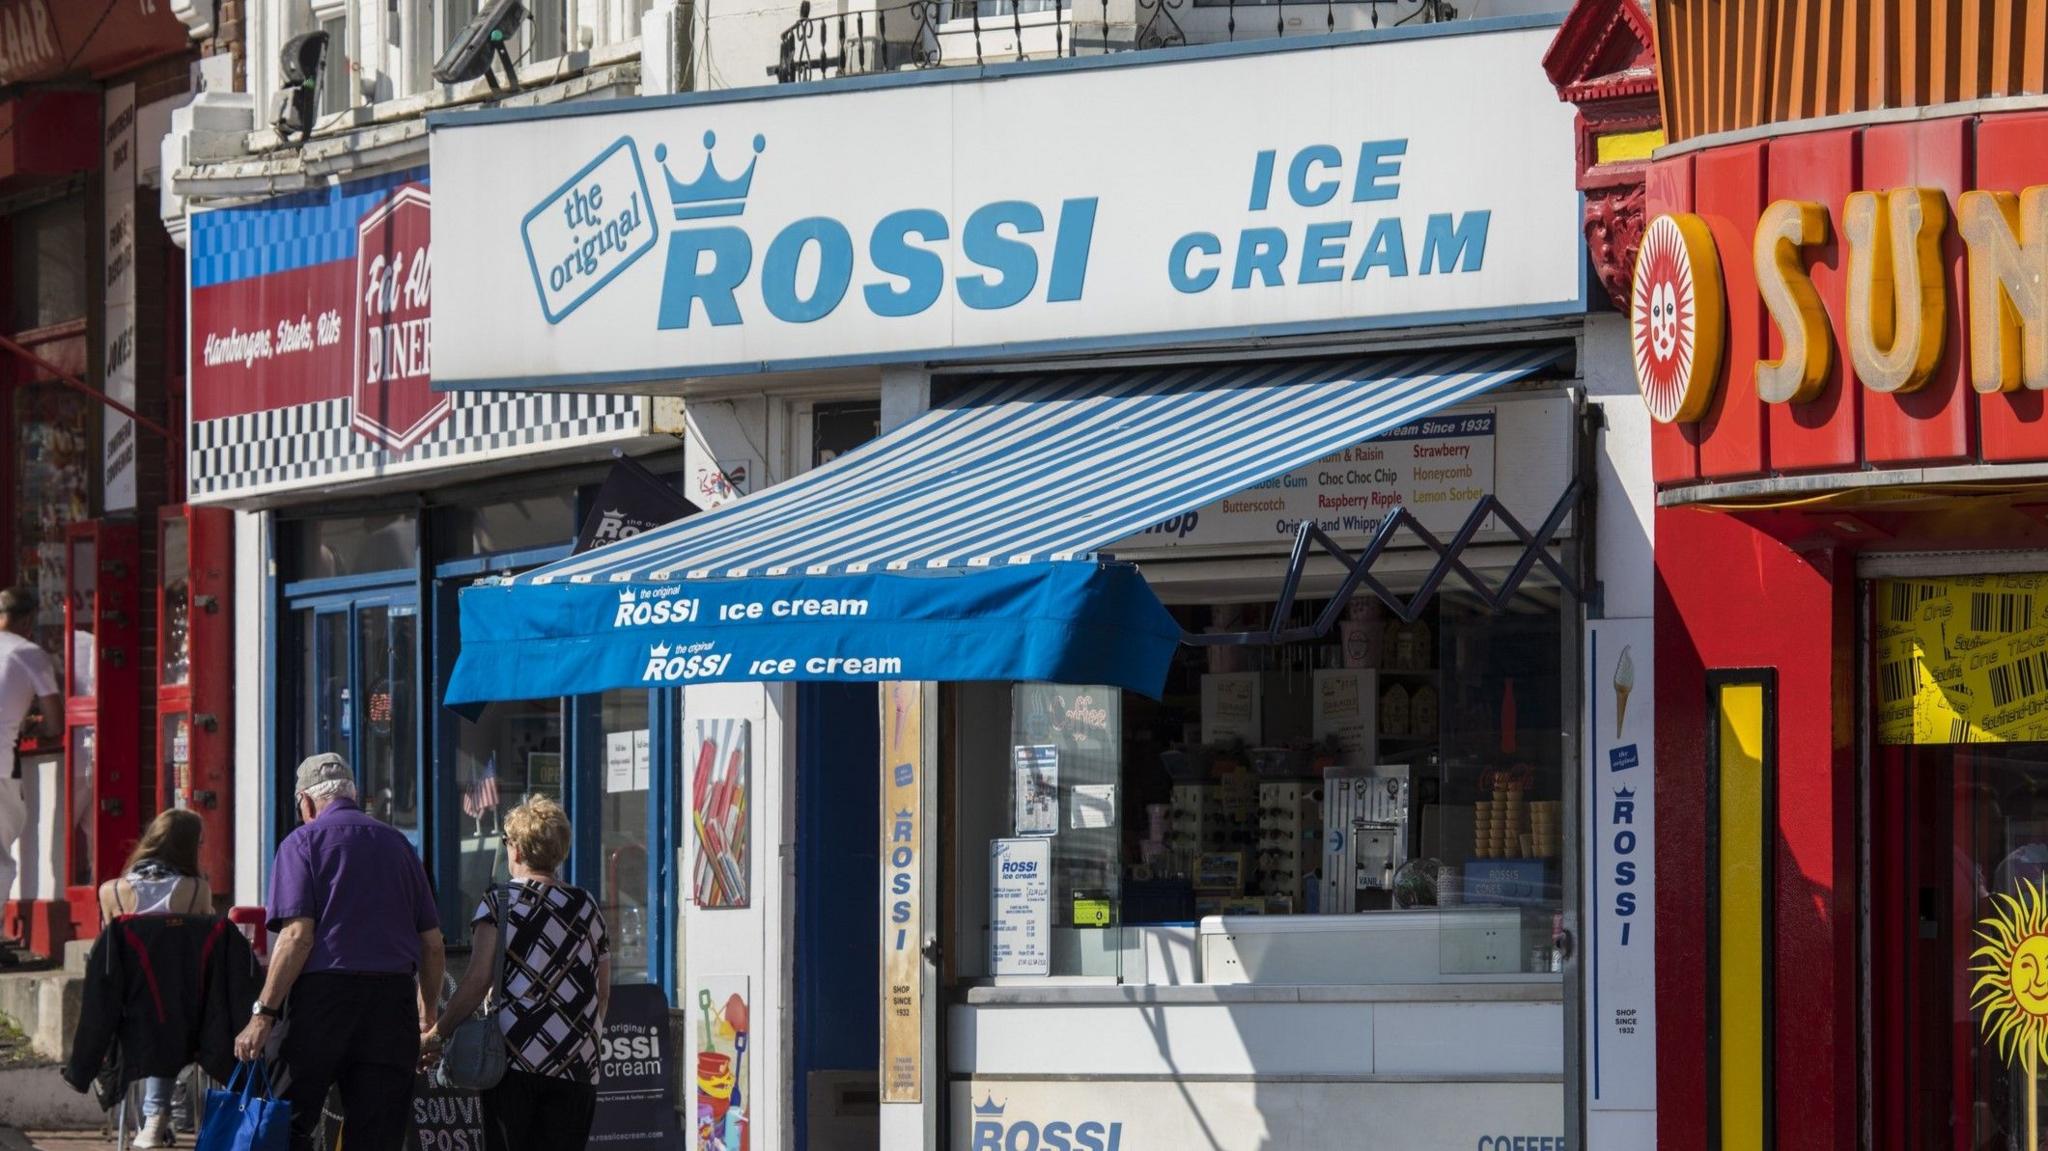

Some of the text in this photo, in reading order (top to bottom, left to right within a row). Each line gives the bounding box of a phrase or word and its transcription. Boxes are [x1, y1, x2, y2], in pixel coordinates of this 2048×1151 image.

[0, 0, 54, 86] AAR
[1248, 138, 1408, 211] ICE
[564, 184, 603, 229] the
[550, 191, 641, 292] original
[1168, 209, 1491, 294] CREAM
[657, 196, 1099, 330] ROSSI
[365, 251, 402, 317] Fat
[1753, 182, 2048, 404] SUN
[204, 309, 341, 368] Hamburgers, Steaks, Ribs
[1422, 422, 1456, 434] Since
[1459, 418, 1491, 432] 1932
[1344, 448, 1352, 462] &
[1355, 446, 1384, 461] Raisin
[1413, 443, 1471, 459] Strawberry
[1283, 474, 1308, 488] Gum
[1318, 468, 1397, 486] Choc Choc Chip
[1413, 464, 1473, 483] Honeycomb
[1318, 491, 1402, 511] Raspberry Ripple
[1413, 485, 1483, 503] Lemon Sorbet
[1222, 498, 1285, 514] Butterscotch
[1321, 516, 1340, 531] and
[1343, 515, 1380, 533] Whippy
[640, 584, 681, 599] the original
[614, 598, 869, 627] ROSSI ice cream
[675, 644, 687, 655] the
[642, 653, 901, 681] ROSSI ice cream
[540, 766, 560, 784] OPE
[1002, 861, 1038, 872] ROSSI
[1613, 801, 1636, 946] ROSSI
[892, 821, 913, 950] ROSSI
[893, 985, 911, 994] SHOP
[893, 996, 912, 1005] SINCE
[896, 1008, 910, 1016] 1932
[611, 1023, 647, 1034] original
[600, 1027, 660, 1061] ossi
[605, 1058, 661, 1078] cream
[972, 1120, 1122, 1151] ROSSI
